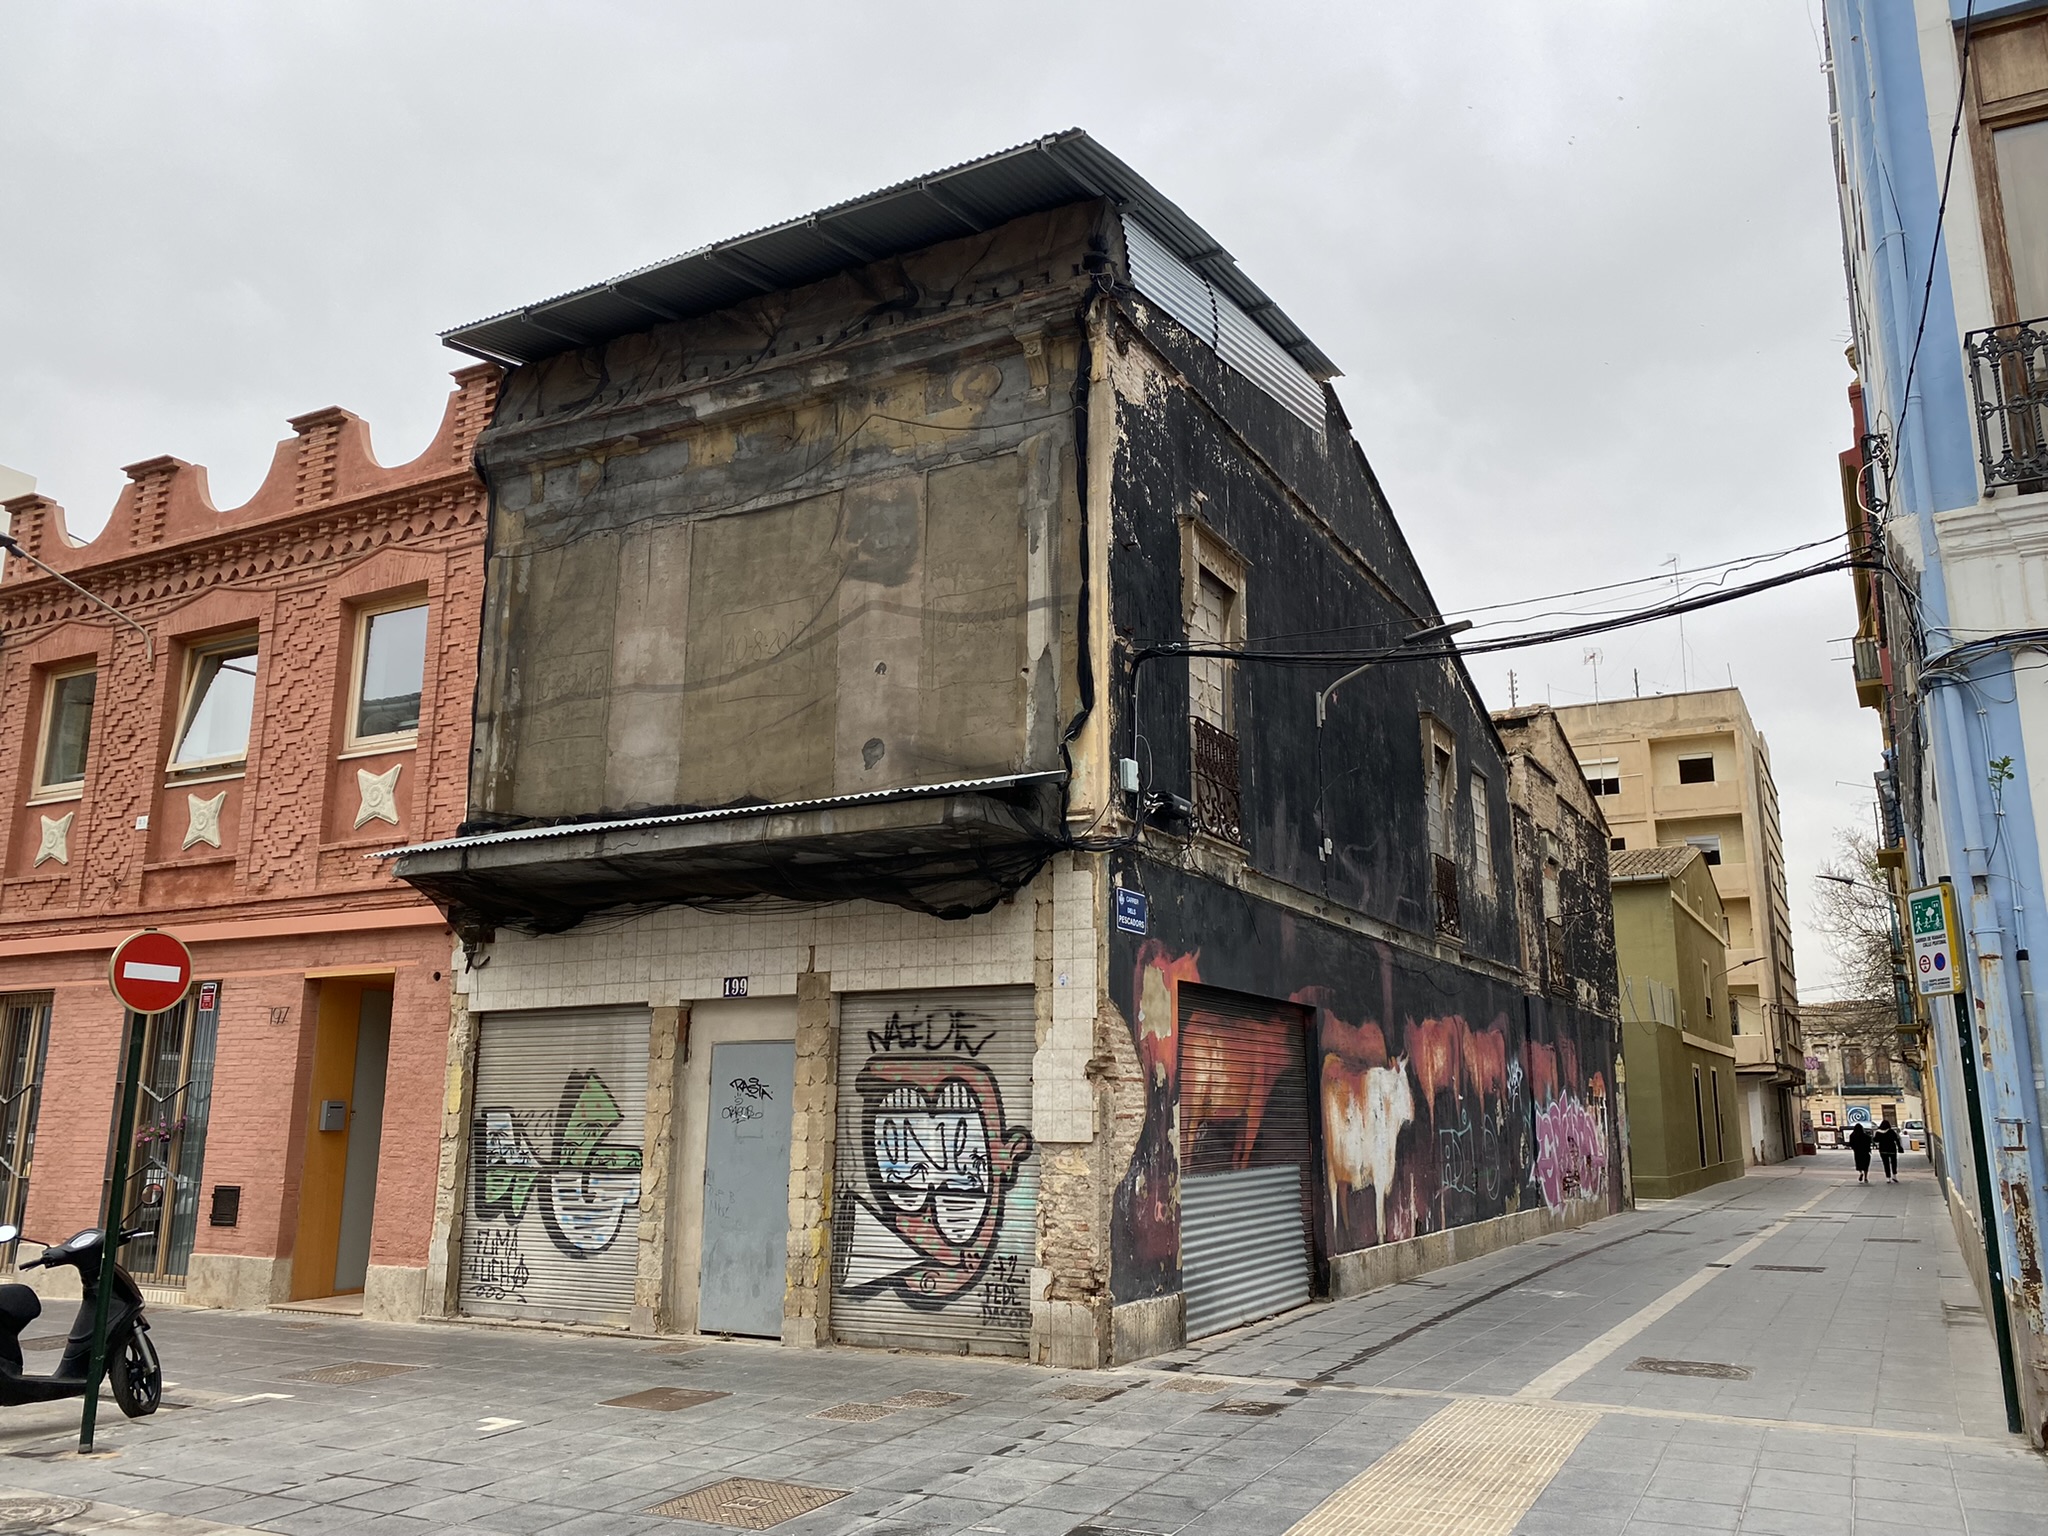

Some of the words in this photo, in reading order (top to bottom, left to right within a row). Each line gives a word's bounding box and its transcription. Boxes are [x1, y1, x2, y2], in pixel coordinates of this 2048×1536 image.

[1119, 915, 1145, 929] PESCADORS
[1953, 965, 1961, 987] VLC
[725, 978, 747, 996] 199
[268, 1006, 291, 1025] 197
